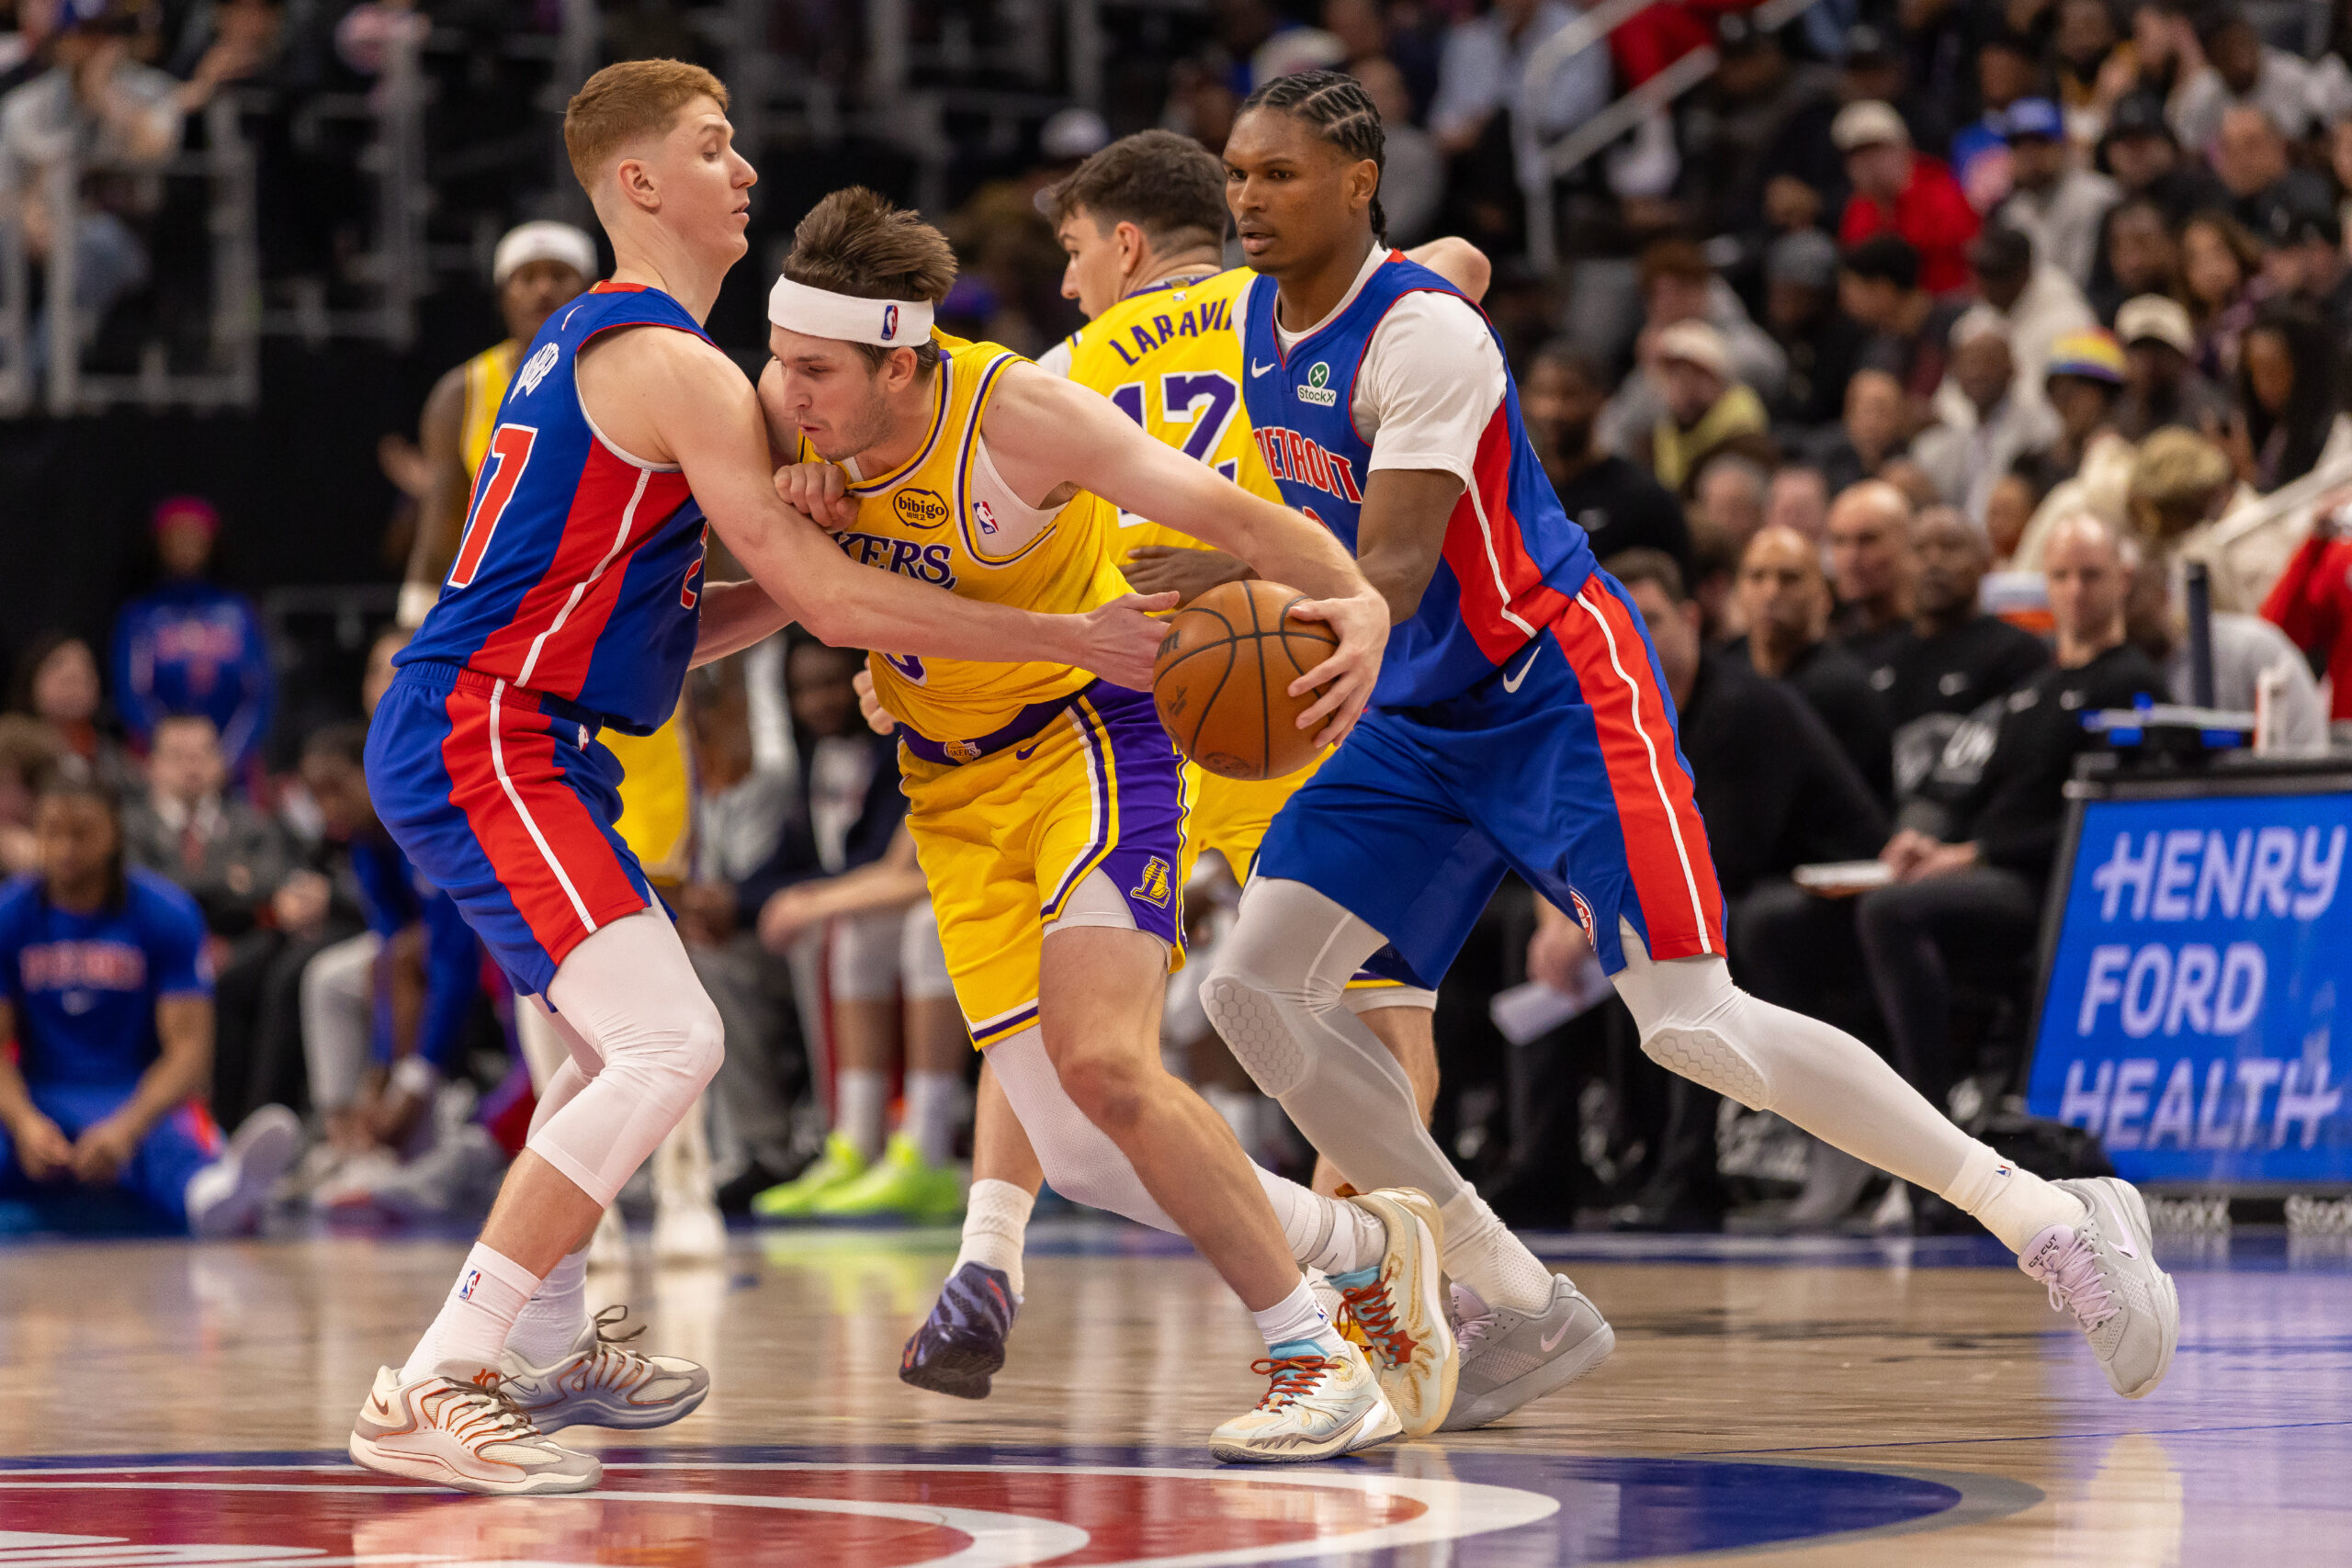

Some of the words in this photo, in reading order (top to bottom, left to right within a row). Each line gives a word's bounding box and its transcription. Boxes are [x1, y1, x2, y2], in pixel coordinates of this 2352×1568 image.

[1298, 386, 1336, 403] StockX
[447, 423, 538, 589] 7
[899, 496, 945, 520] bibigo
[832, 531, 958, 591] KERS
[2091, 825, 2347, 921] HENRY
[2076, 941, 2268, 1039] FORD
[2058, 1056, 2343, 1152] HEALTH
